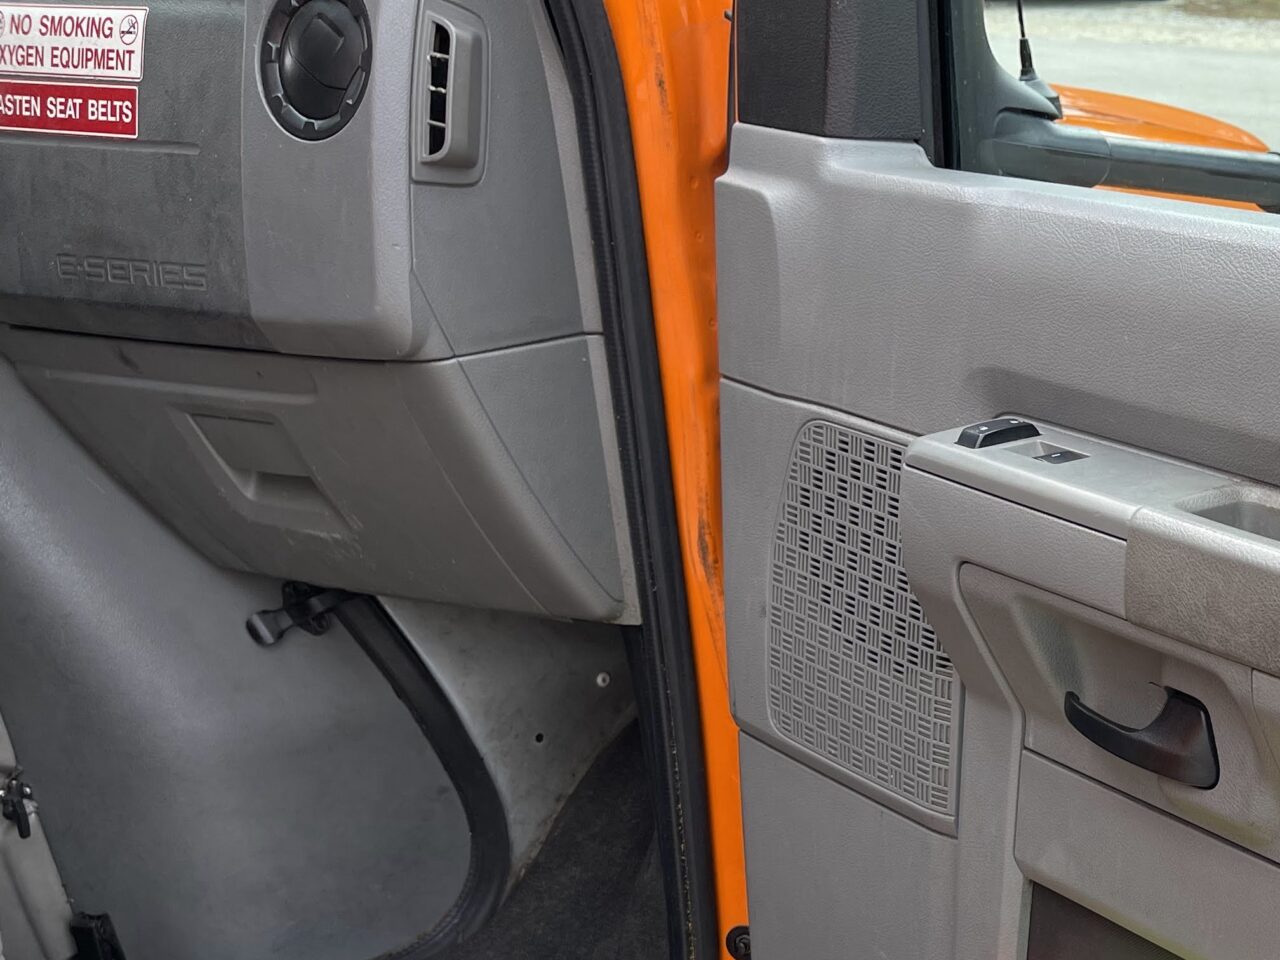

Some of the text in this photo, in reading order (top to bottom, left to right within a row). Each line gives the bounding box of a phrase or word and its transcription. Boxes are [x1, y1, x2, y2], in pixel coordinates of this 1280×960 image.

[10, 14, 114, 39] NO SMOKING
[50, 46, 135, 71] EQUIPMENT
[46, 96, 82, 119] SEAT
[87, 99, 132, 123] BELTS
[56, 252, 207, 291] E-SERIES
